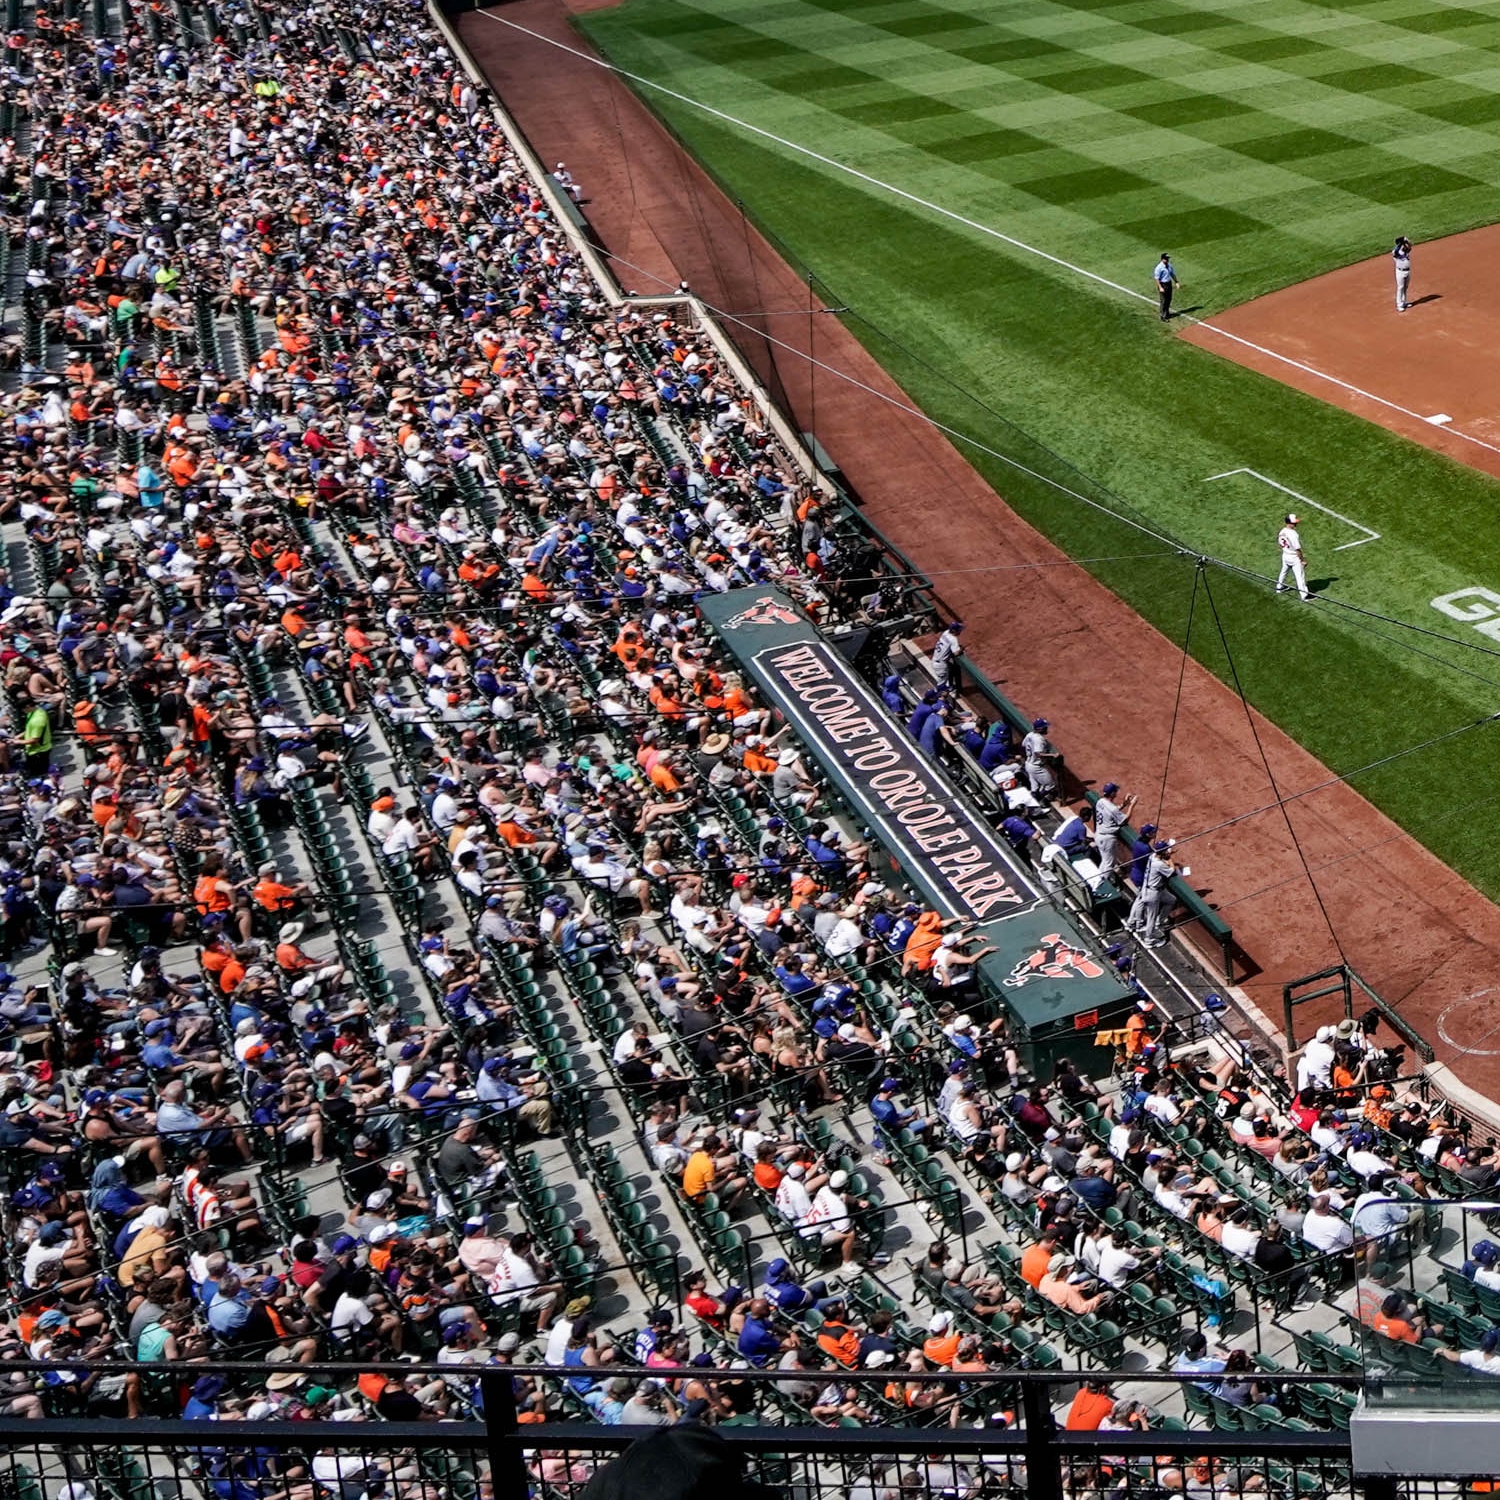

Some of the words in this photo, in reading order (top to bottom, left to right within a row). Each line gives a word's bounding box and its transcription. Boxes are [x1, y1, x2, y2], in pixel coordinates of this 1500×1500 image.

[769, 646, 877, 744] WELCOME
[852, 737, 901, 771] TO
[868, 769, 971, 852] ORIOLE
[930, 843, 1024, 920] PARK
